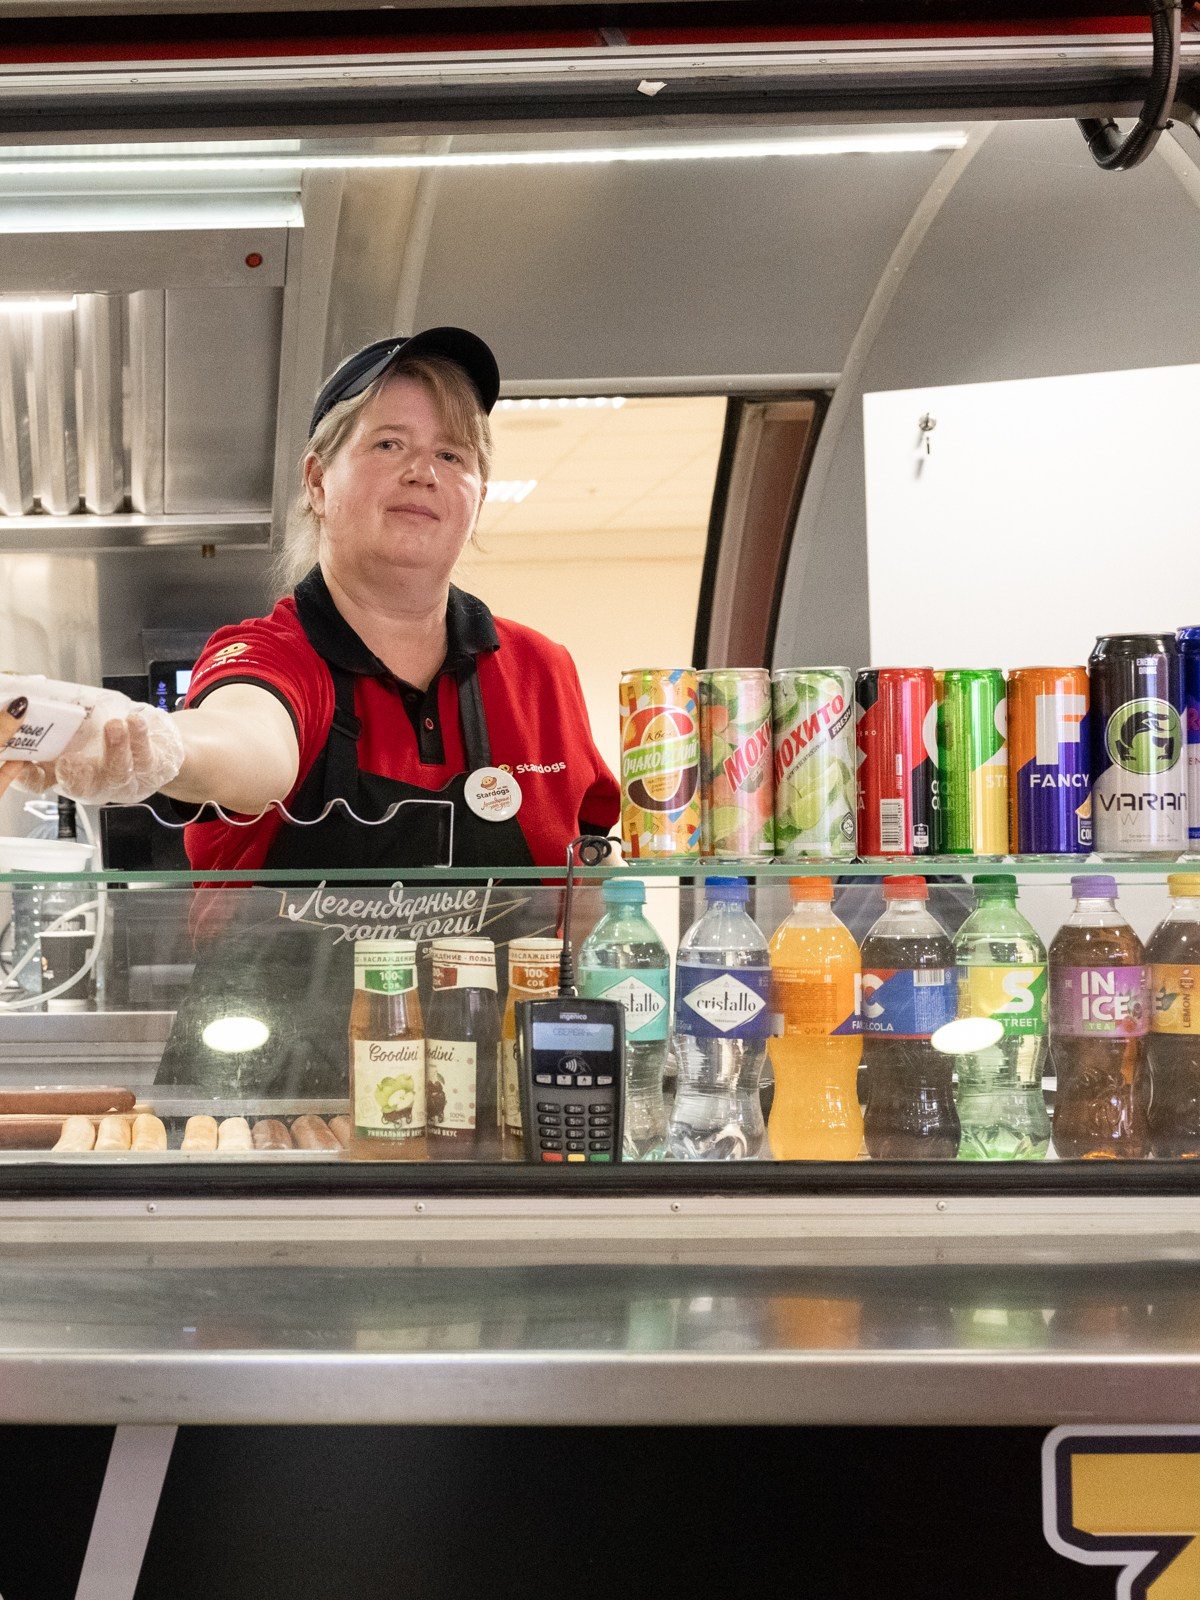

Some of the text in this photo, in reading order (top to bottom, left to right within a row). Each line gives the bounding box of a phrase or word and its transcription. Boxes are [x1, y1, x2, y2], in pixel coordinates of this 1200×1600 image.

[831, 706, 852, 738] FRESH
[723, 710, 772, 794] МОХИ
[516, 761, 567, 774] Stardogs
[1029, 773, 1090, 788] FANCY
[476, 787, 510, 800] Stardogs
[511, 952, 560, 961] НАСЛАЖДЕНИ
[526, 979, 545, 988] СОК
[1080, 970, 1115, 995] IN
[623, 992, 660, 1013] stallo
[696, 992, 756, 1013] cristallo
[1082, 996, 1130, 1021] ICE
[1183, 992, 1191, 1028] LEMON
[560, 1012, 588, 1022] ingenico
[1003, 1017, 1038, 1028] TREET
[1088, 1022, 1110, 1031] TEA
[369, 1043, 419, 1063] Goodini
